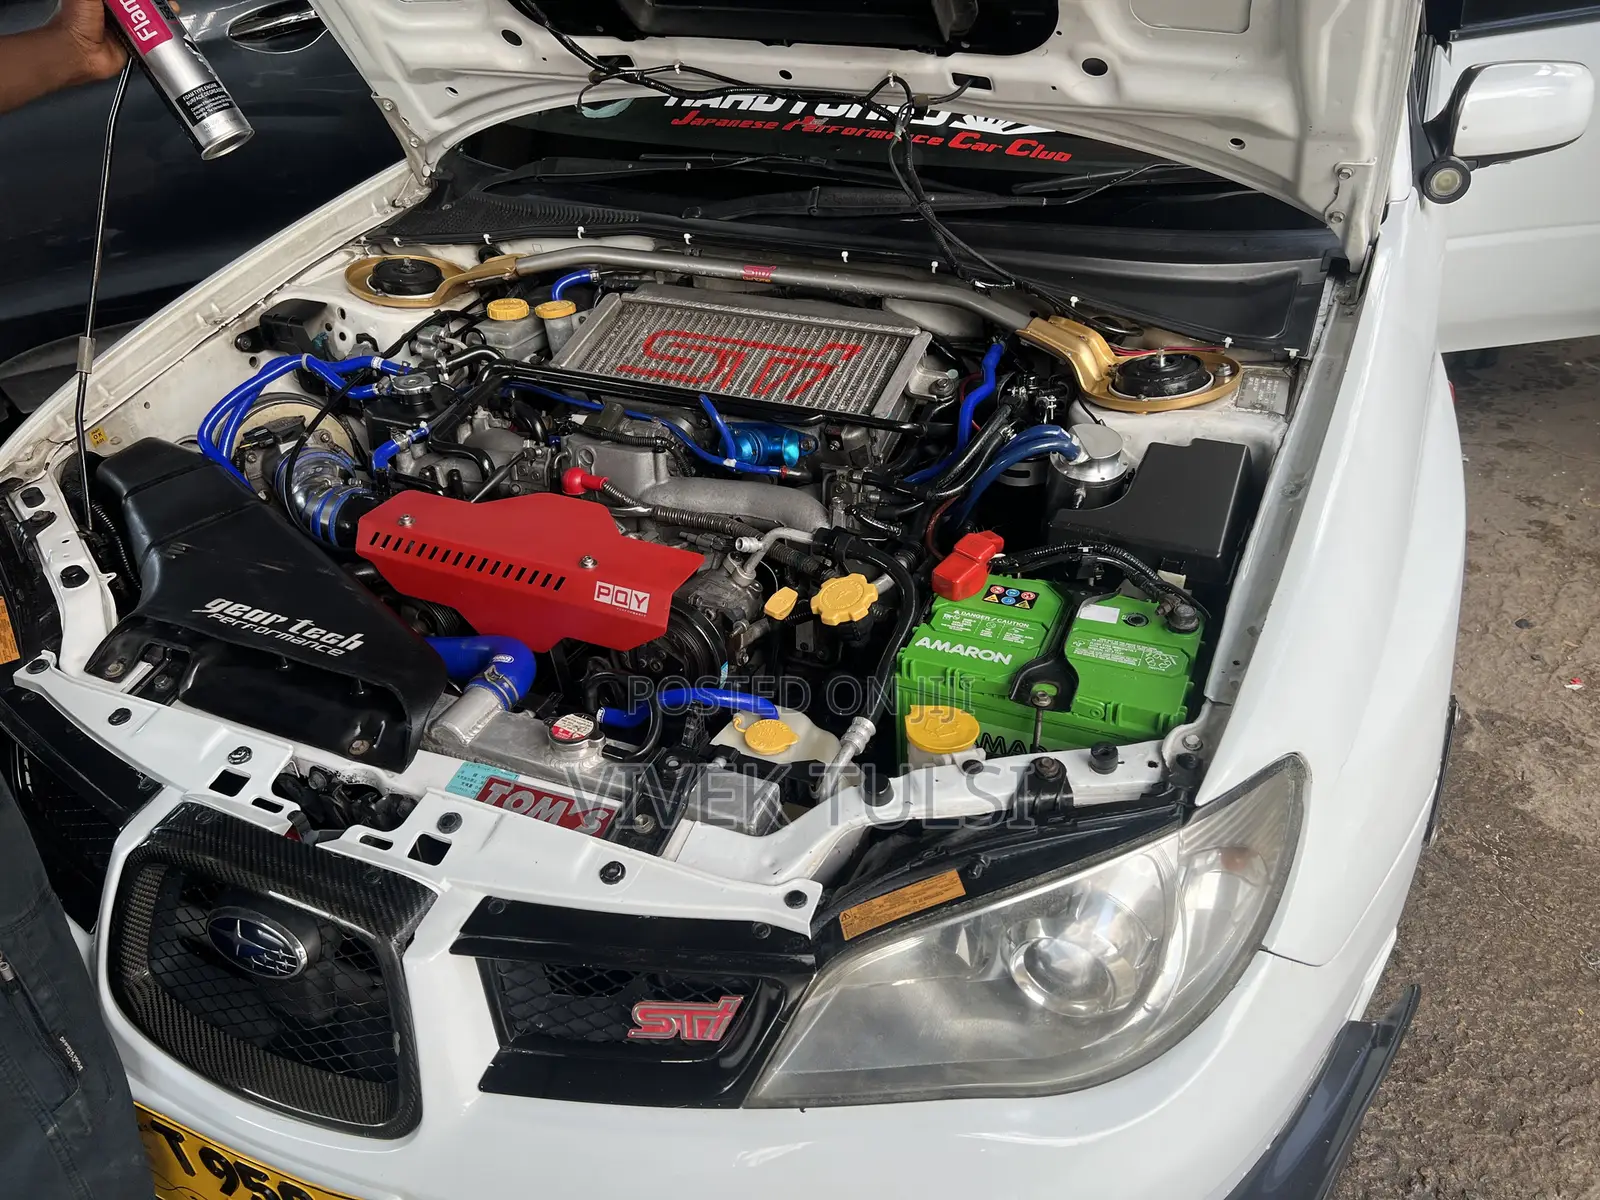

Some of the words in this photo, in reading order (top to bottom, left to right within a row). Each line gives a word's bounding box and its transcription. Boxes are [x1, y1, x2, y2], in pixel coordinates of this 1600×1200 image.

[948, 131, 1003, 153] Car
[596, 585, 648, 609] PQY
[191, 598, 289, 626] gear
[288, 618, 364, 651] tech
[915, 636, 1012, 665] AMARON
[151, 1118, 196, 1177] T
